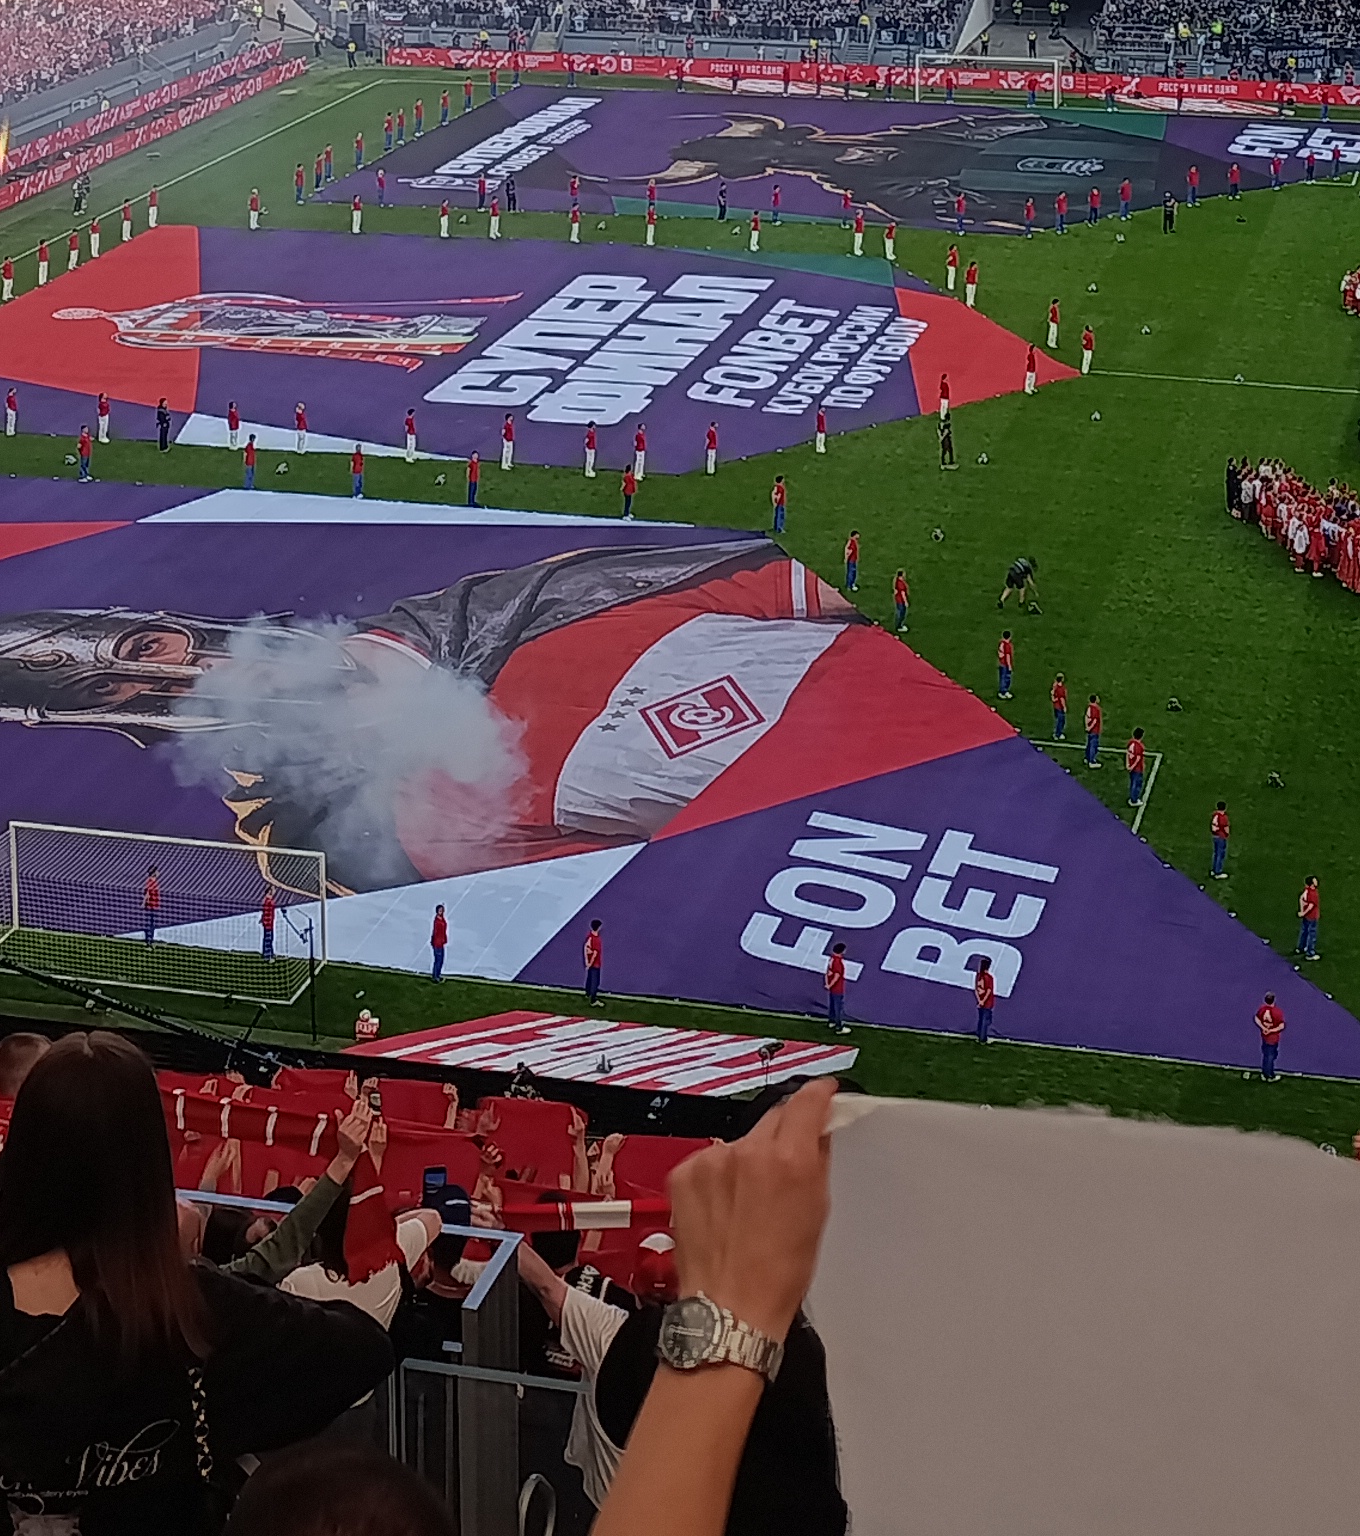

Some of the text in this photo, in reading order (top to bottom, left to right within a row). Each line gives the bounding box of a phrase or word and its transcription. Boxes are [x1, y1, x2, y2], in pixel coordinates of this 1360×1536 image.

[1157, 82, 1189, 93] РОССЯ
[1228, 123, 1309, 159] FON
[423, 274, 648, 407] СУПЕР
[526, 274, 776, 426] ФИНАЛ
[686, 298, 840, 408] FONBET
[761, 305, 894, 415] КУБОК РОССИИ
[820, 316, 928, 409] ПО ФУТБОЛУ
[740, 810, 929, 982] FON
[880, 829, 1060, 999] BET
